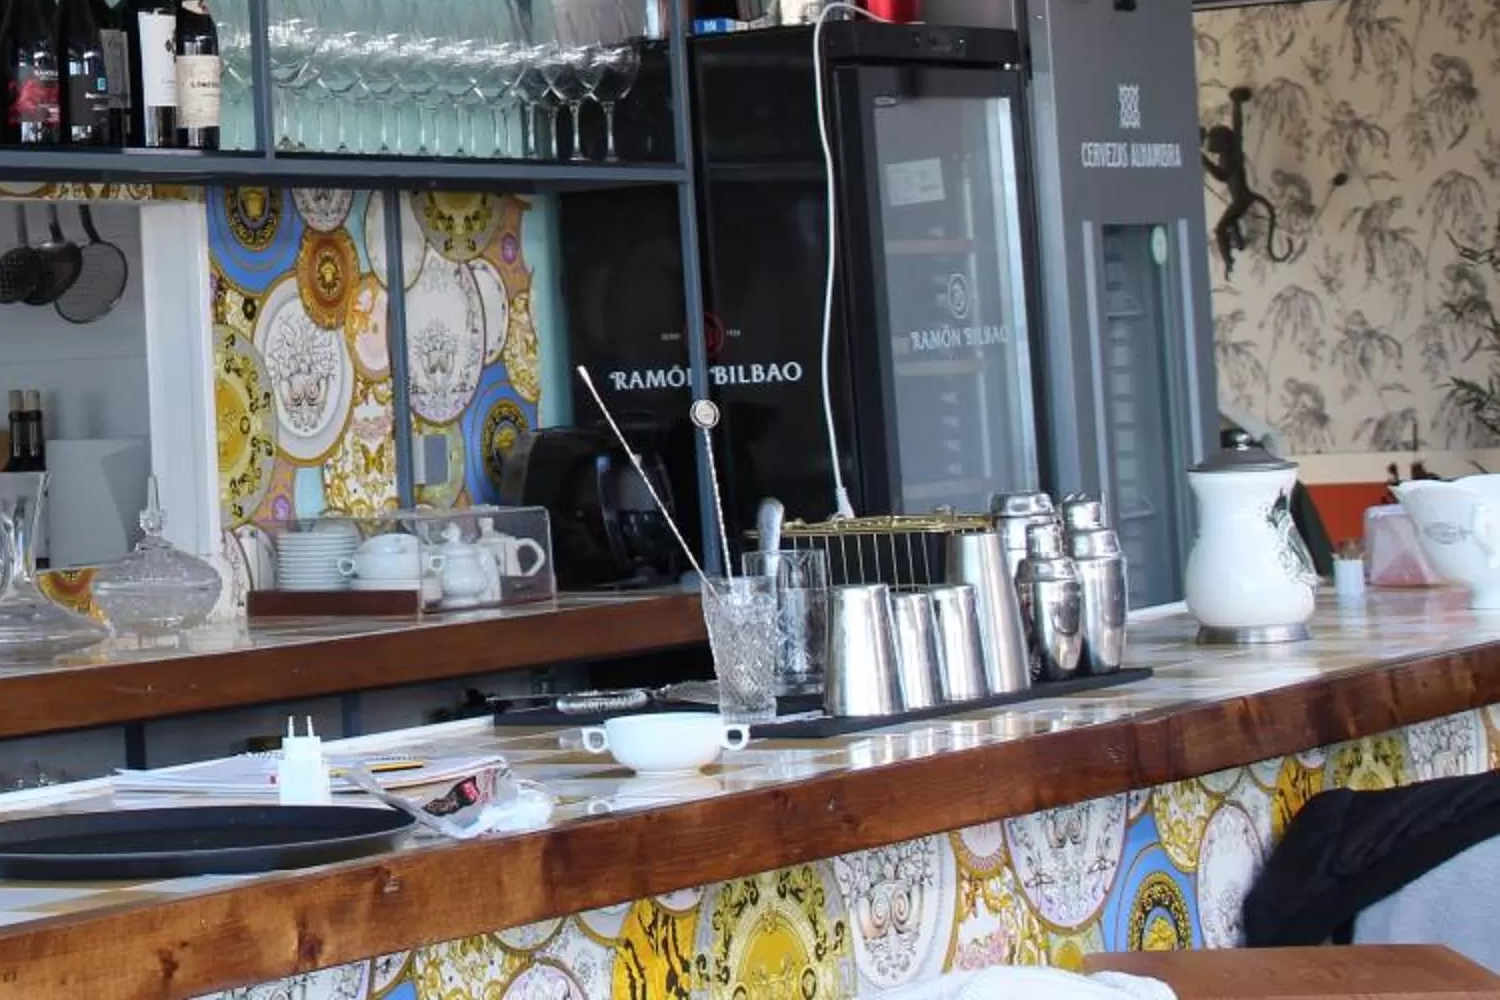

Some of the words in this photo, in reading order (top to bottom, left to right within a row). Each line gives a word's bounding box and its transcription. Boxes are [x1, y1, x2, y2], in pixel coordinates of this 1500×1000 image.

[1081, 141, 1129, 168] CERVEZAS
[1131, 142, 1182, 168] ALHAMBRA
[709, 360, 803, 386] BILBAO
